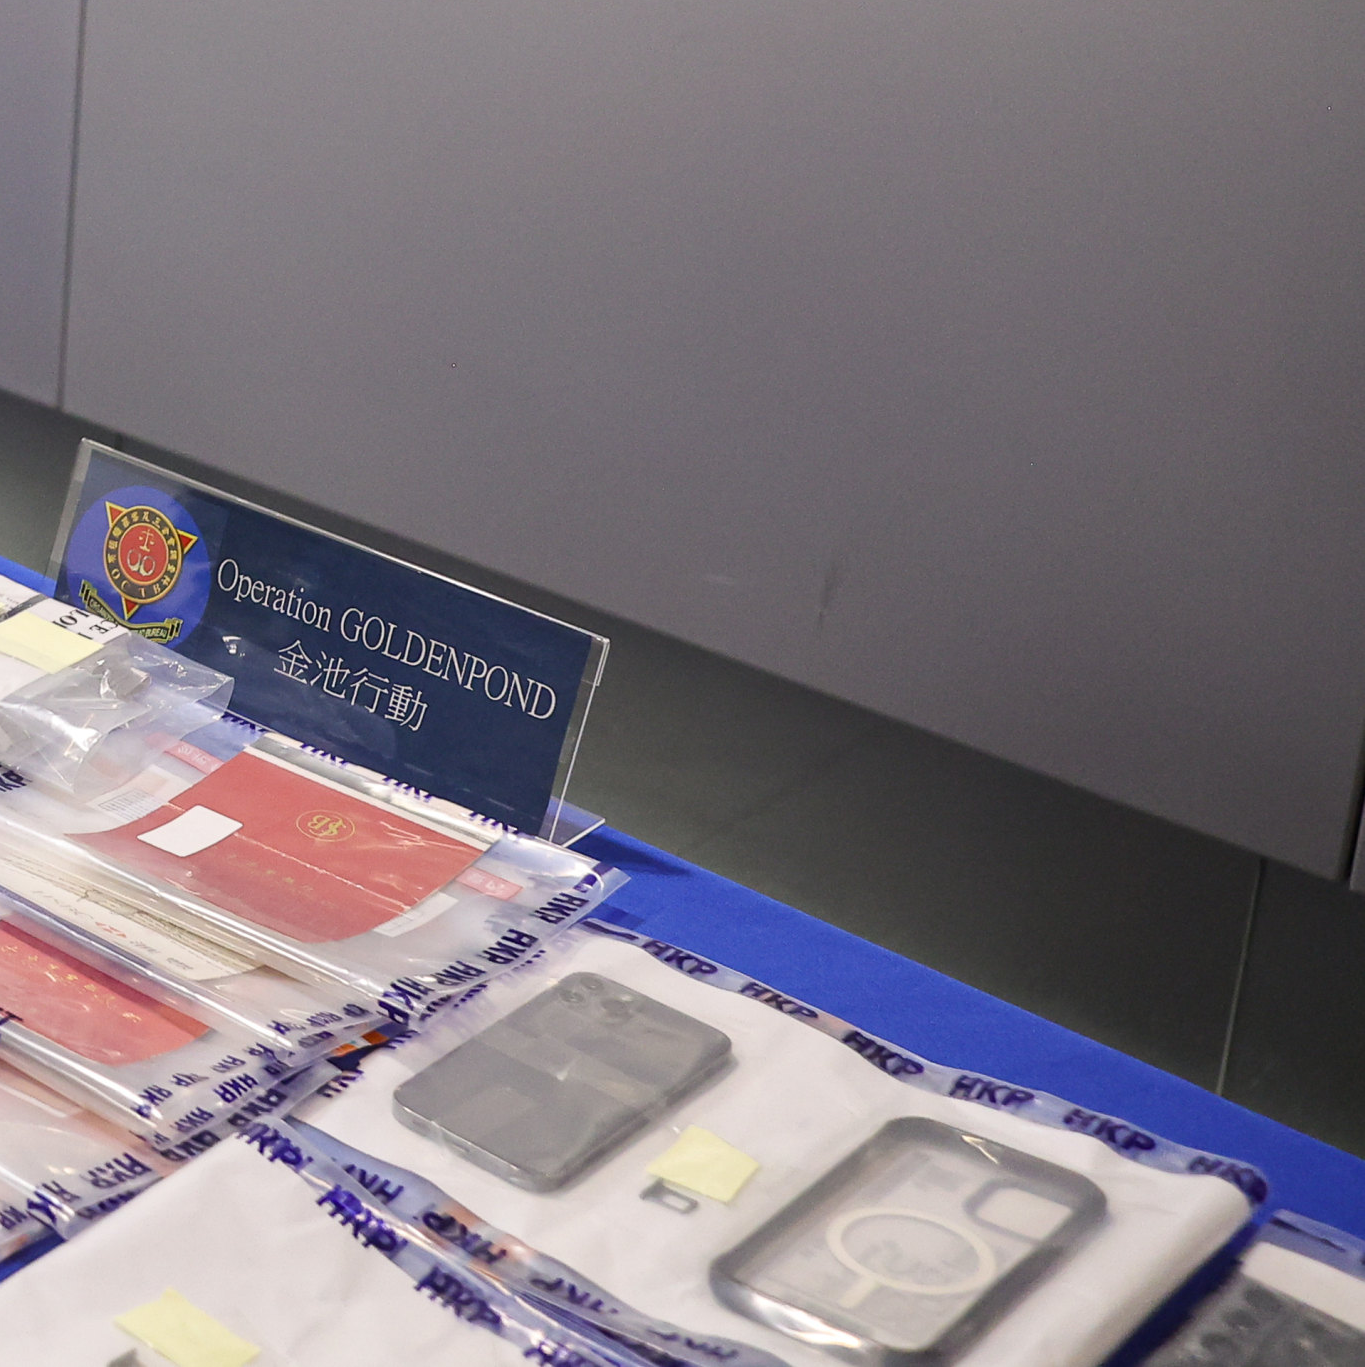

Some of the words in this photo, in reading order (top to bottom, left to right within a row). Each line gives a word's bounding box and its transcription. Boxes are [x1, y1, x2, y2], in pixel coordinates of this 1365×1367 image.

[218, 558, 332, 632] Operation
[339, 607, 557, 721] GOLDENPOND
[273, 638, 430, 731] 金池行動
[641, 939, 719, 975] HKP
[737, 982, 820, 1019] HKP
[841, 1030, 925, 1077] HKP
[947, 1074, 1034, 1107] HKP
[1063, 1108, 1156, 1152] HKP
